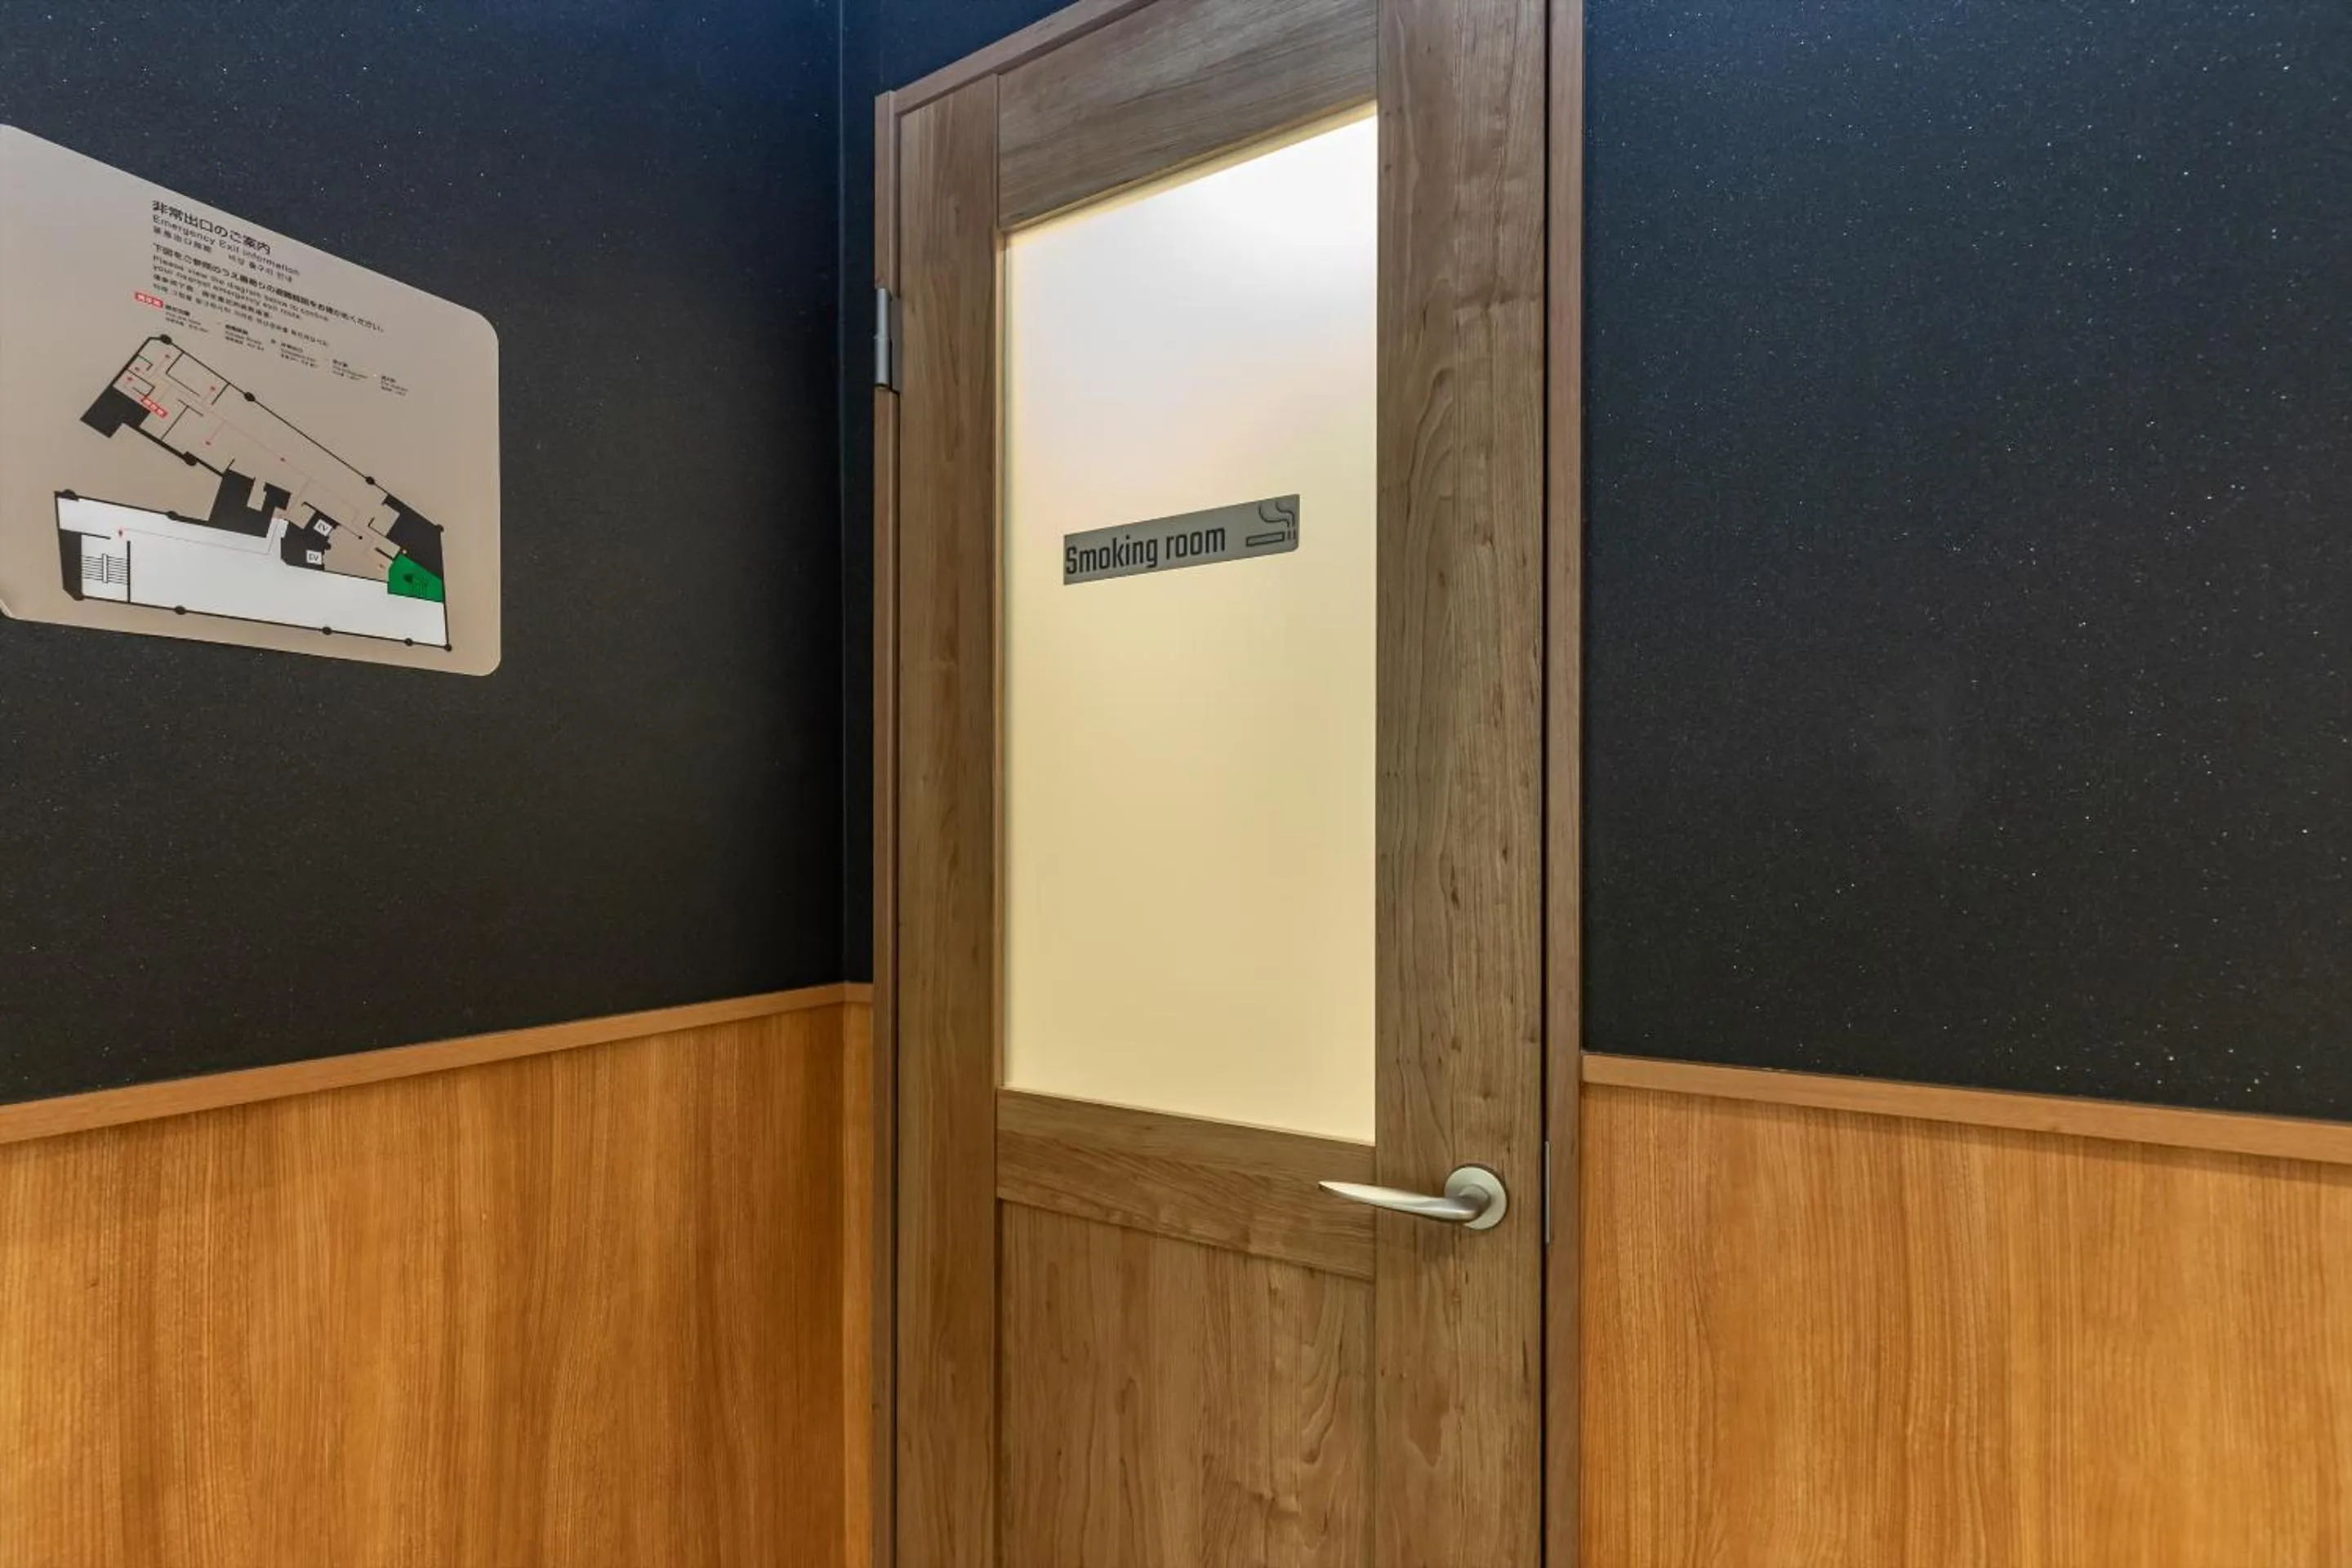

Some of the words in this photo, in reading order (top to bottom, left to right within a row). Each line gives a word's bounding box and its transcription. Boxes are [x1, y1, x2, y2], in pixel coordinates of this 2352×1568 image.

[153, 200, 271, 255] 非常出口のご案内
[153, 214, 216, 246] Emergency
[219, 239, 239, 254] Exit
[1066, 535, 1159, 574] Smoking
[1166, 527, 1226, 559] room
